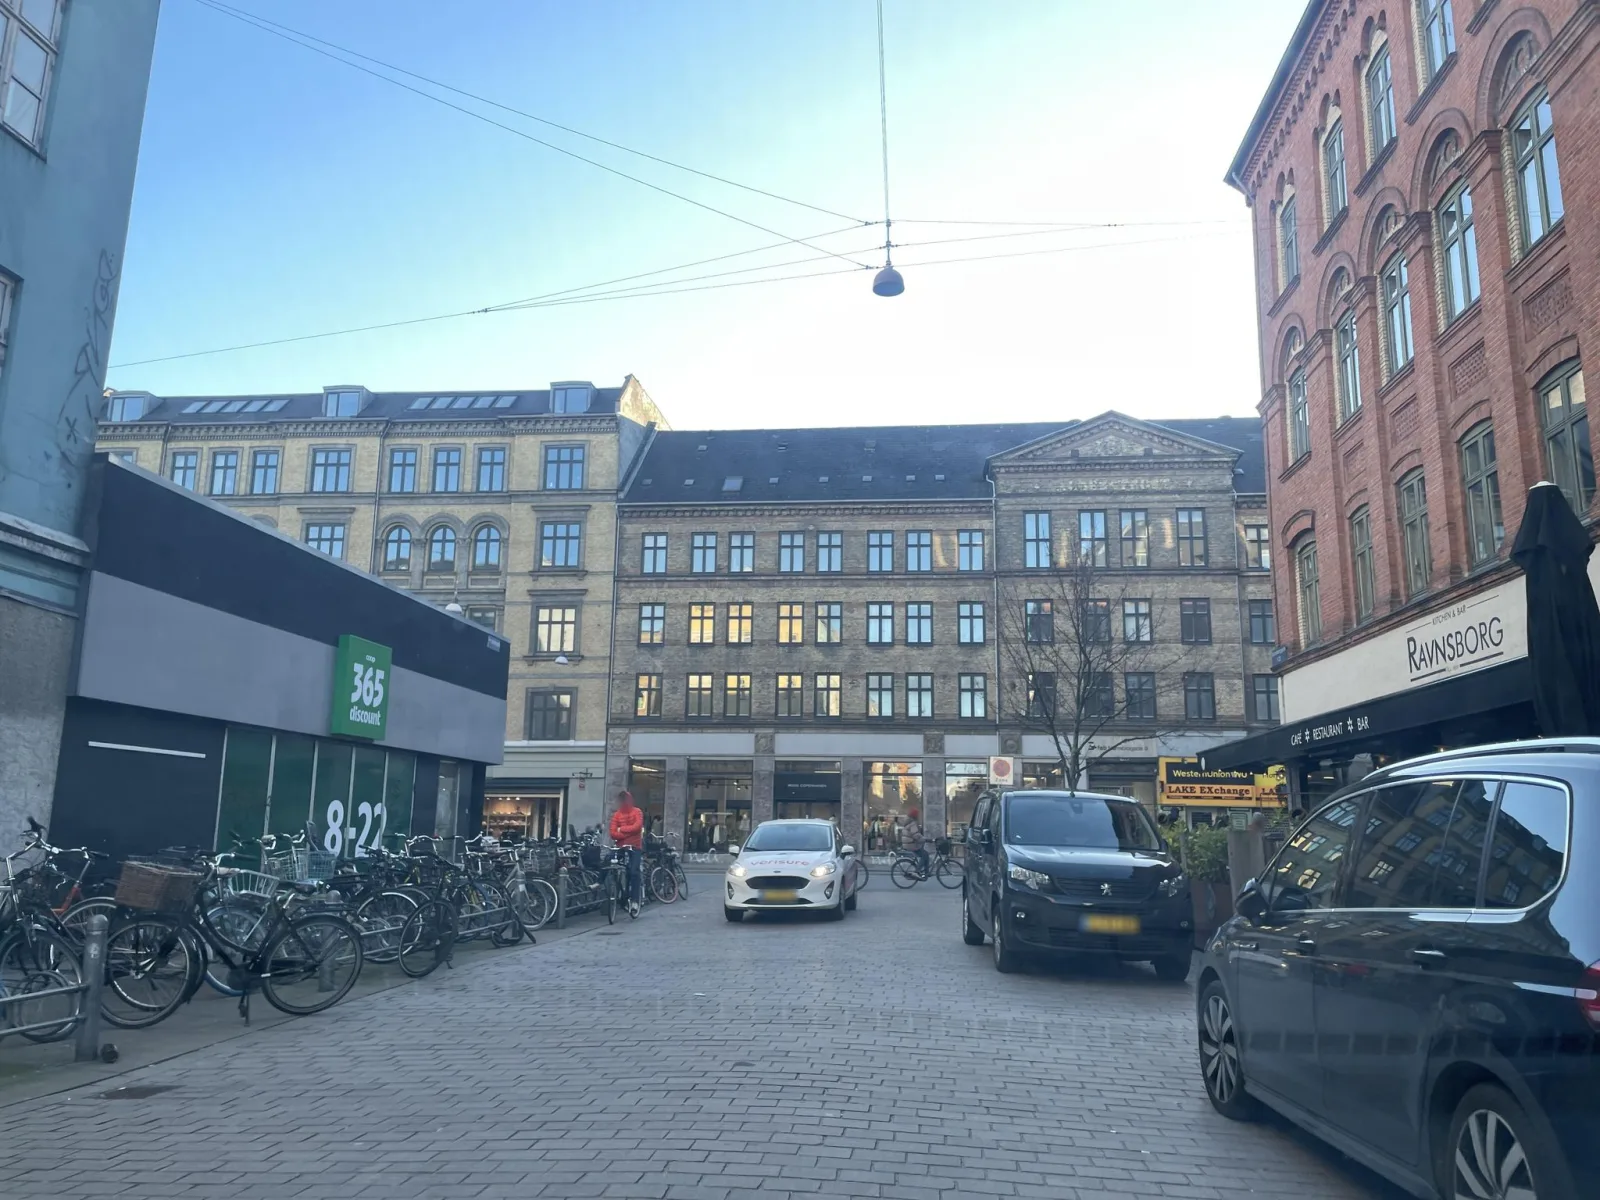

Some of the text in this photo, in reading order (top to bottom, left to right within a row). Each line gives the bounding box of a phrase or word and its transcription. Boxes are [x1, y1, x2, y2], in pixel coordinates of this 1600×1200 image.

[1432, 611, 1452, 625] KITCHEN
[1457, 604, 1466, 616] BAR
[1406, 616, 1504, 674] RAVNSBORG
[365, 654, 376, 663] coop
[351, 662, 385, 708] 365
[349, 705, 381, 726] discount
[1290, 716, 1369, 746] CAFÉ RESTAURANT BAR
[1168, 786, 1250, 796] LAKE EXchange
[324, 799, 387, 858] 8-22
